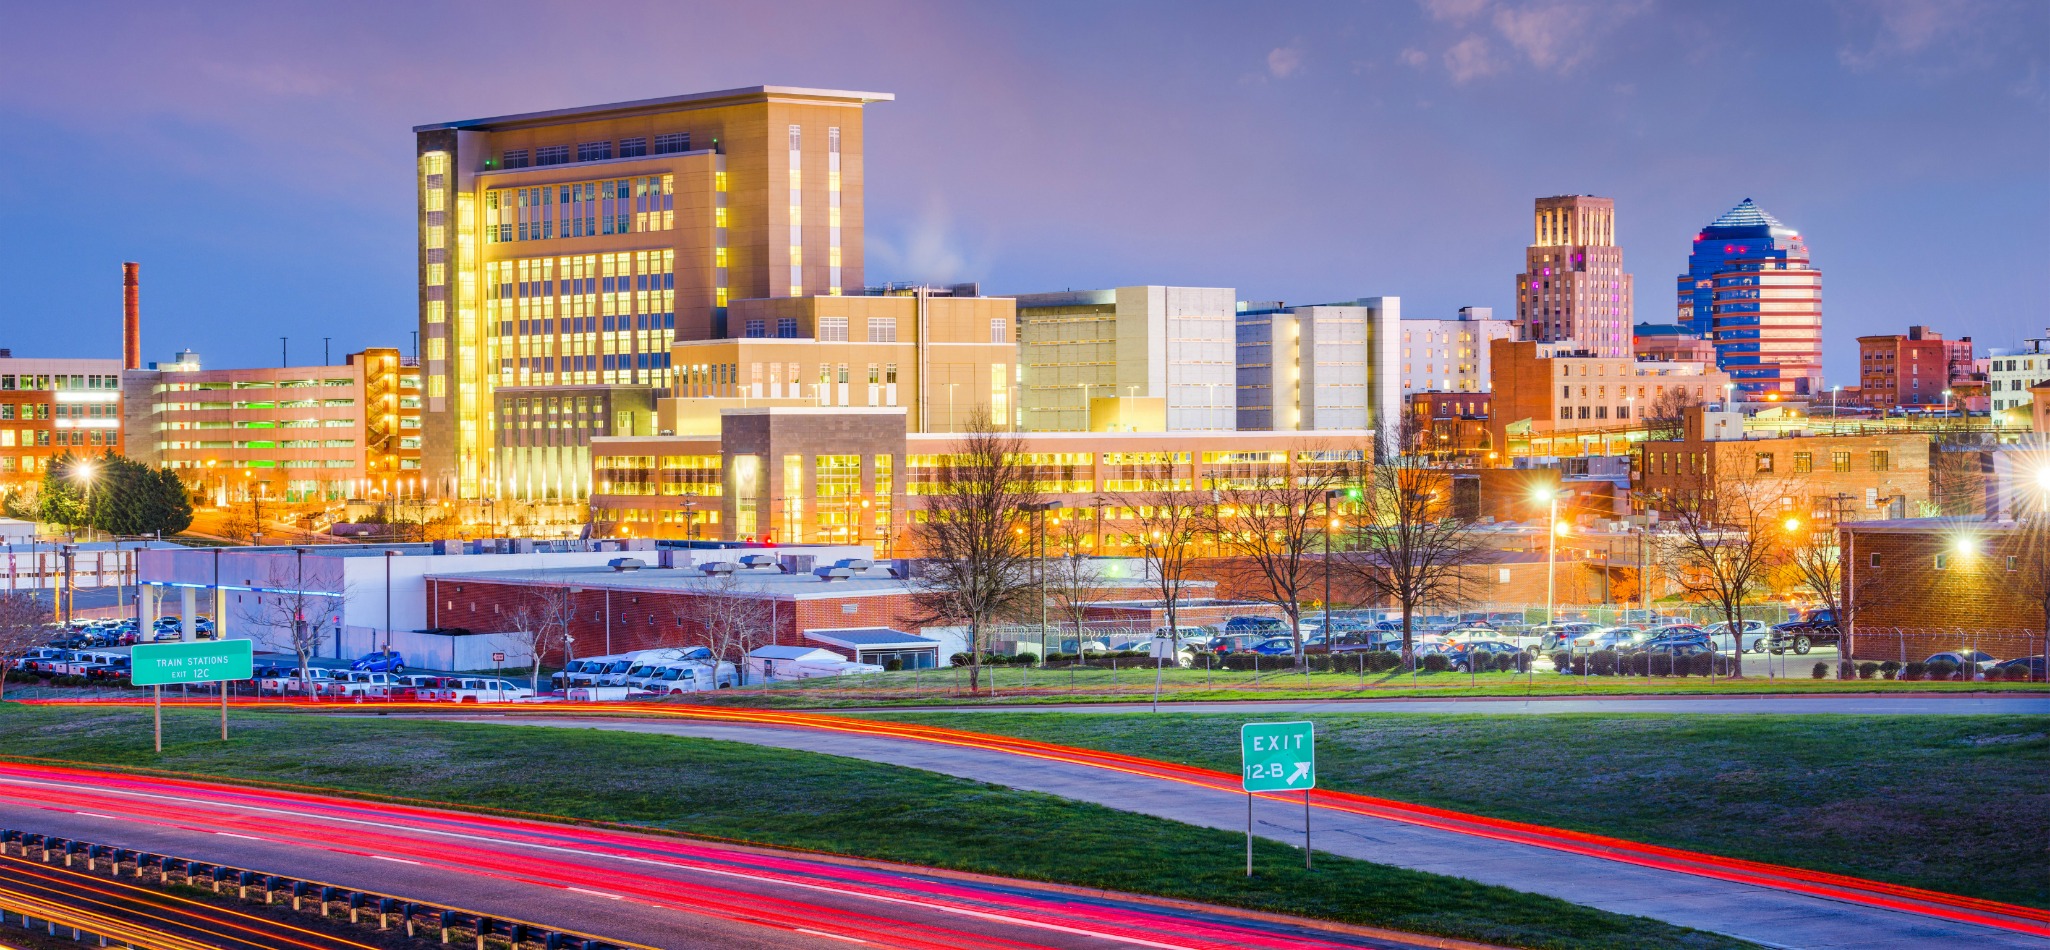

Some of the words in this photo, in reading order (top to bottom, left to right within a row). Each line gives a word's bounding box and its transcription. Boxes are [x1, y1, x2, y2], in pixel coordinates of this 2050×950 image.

[156, 658, 182, 667] TRAIN
[187, 655, 229, 666] STATIONS
[171, 670, 187, 678] EXIT
[193, 668, 210, 678] 12C
[1253, 734, 1304, 752] EXIT
[1246, 762, 1284, 780] 12-B
